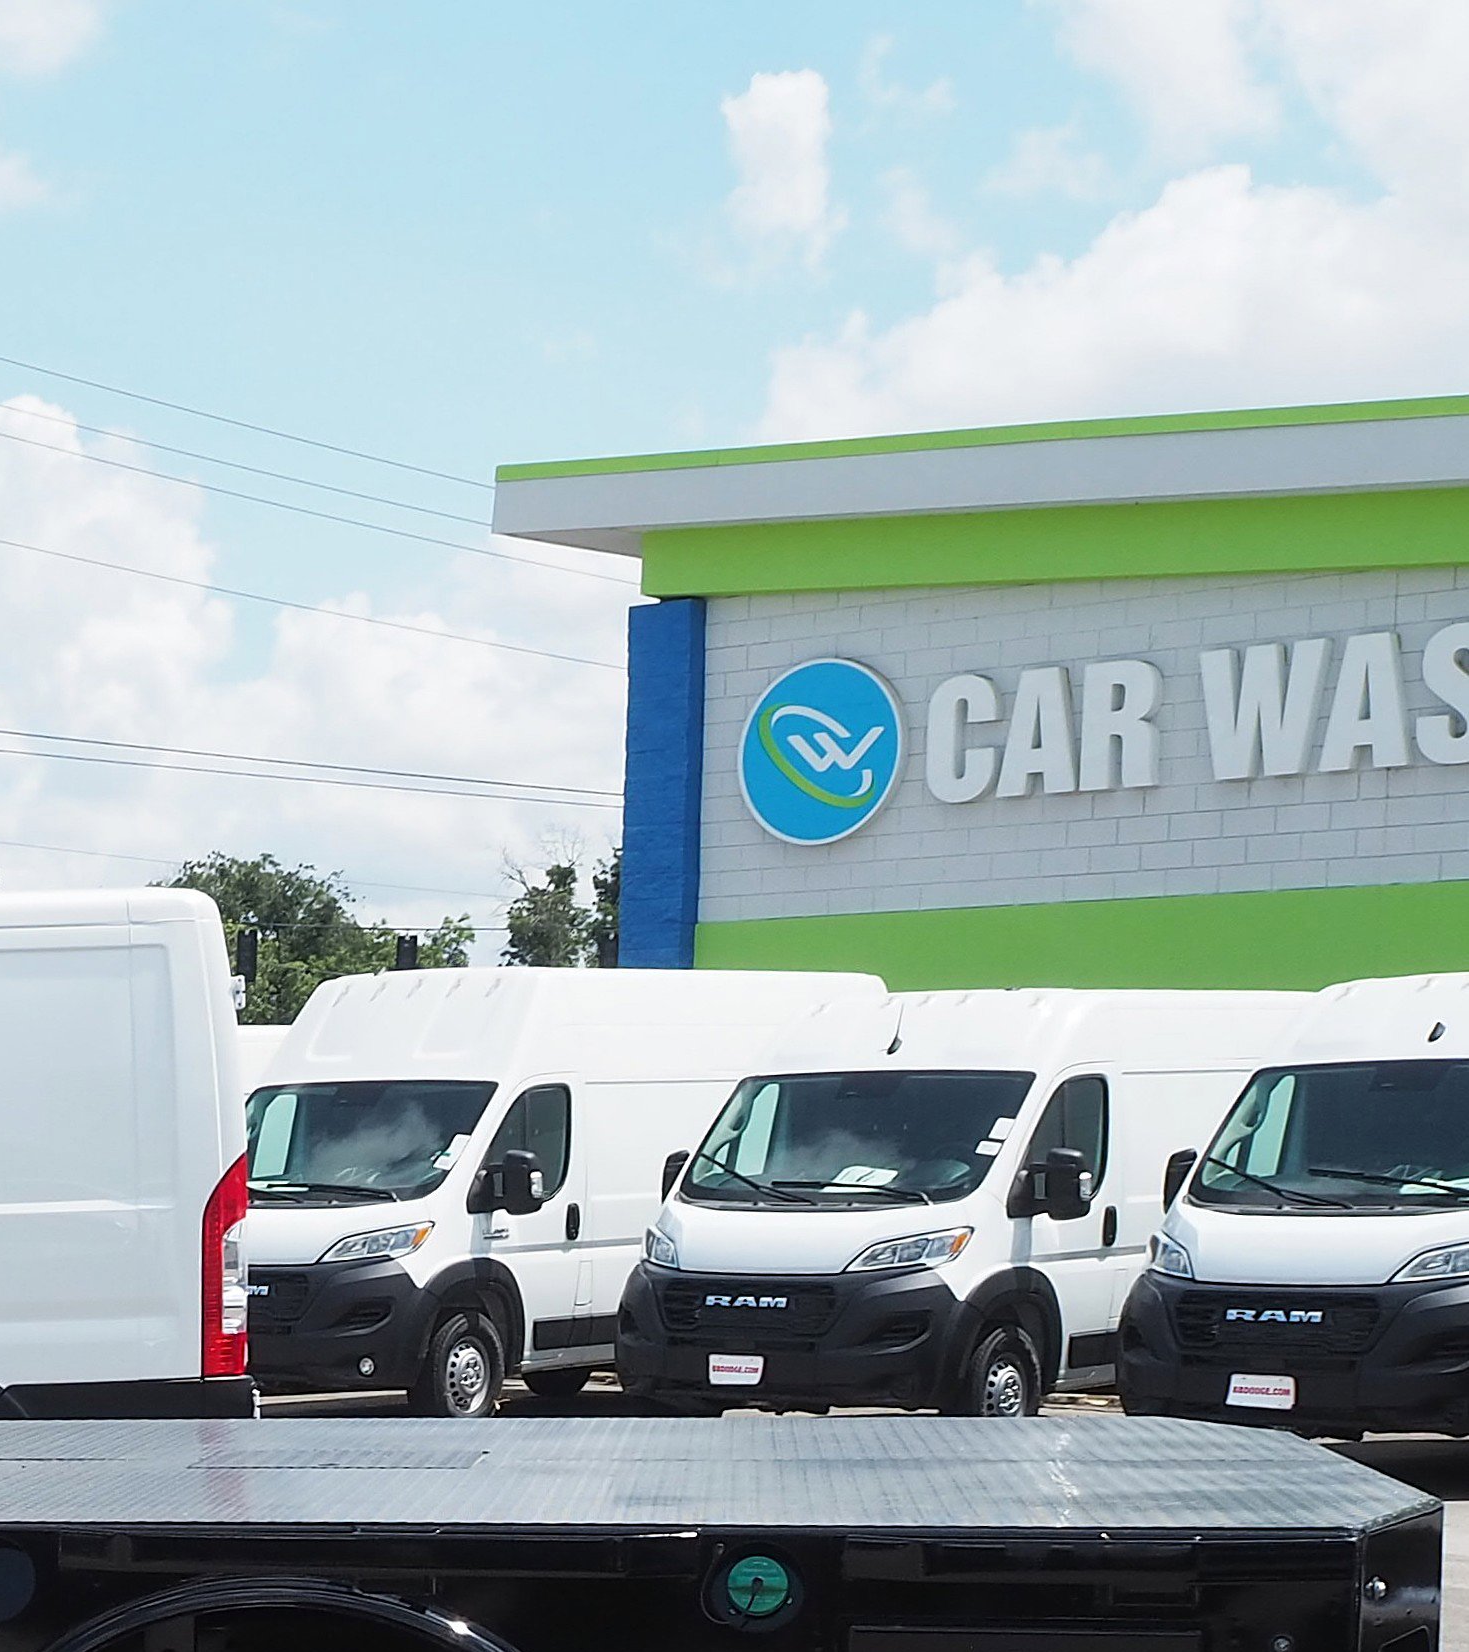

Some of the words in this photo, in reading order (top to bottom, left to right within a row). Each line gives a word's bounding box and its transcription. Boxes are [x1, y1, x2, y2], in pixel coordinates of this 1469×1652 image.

[925, 659, 1162, 803] CAR
[705, 1295, 788, 1308] RAM
[1226, 1309, 1323, 1323] RAM
